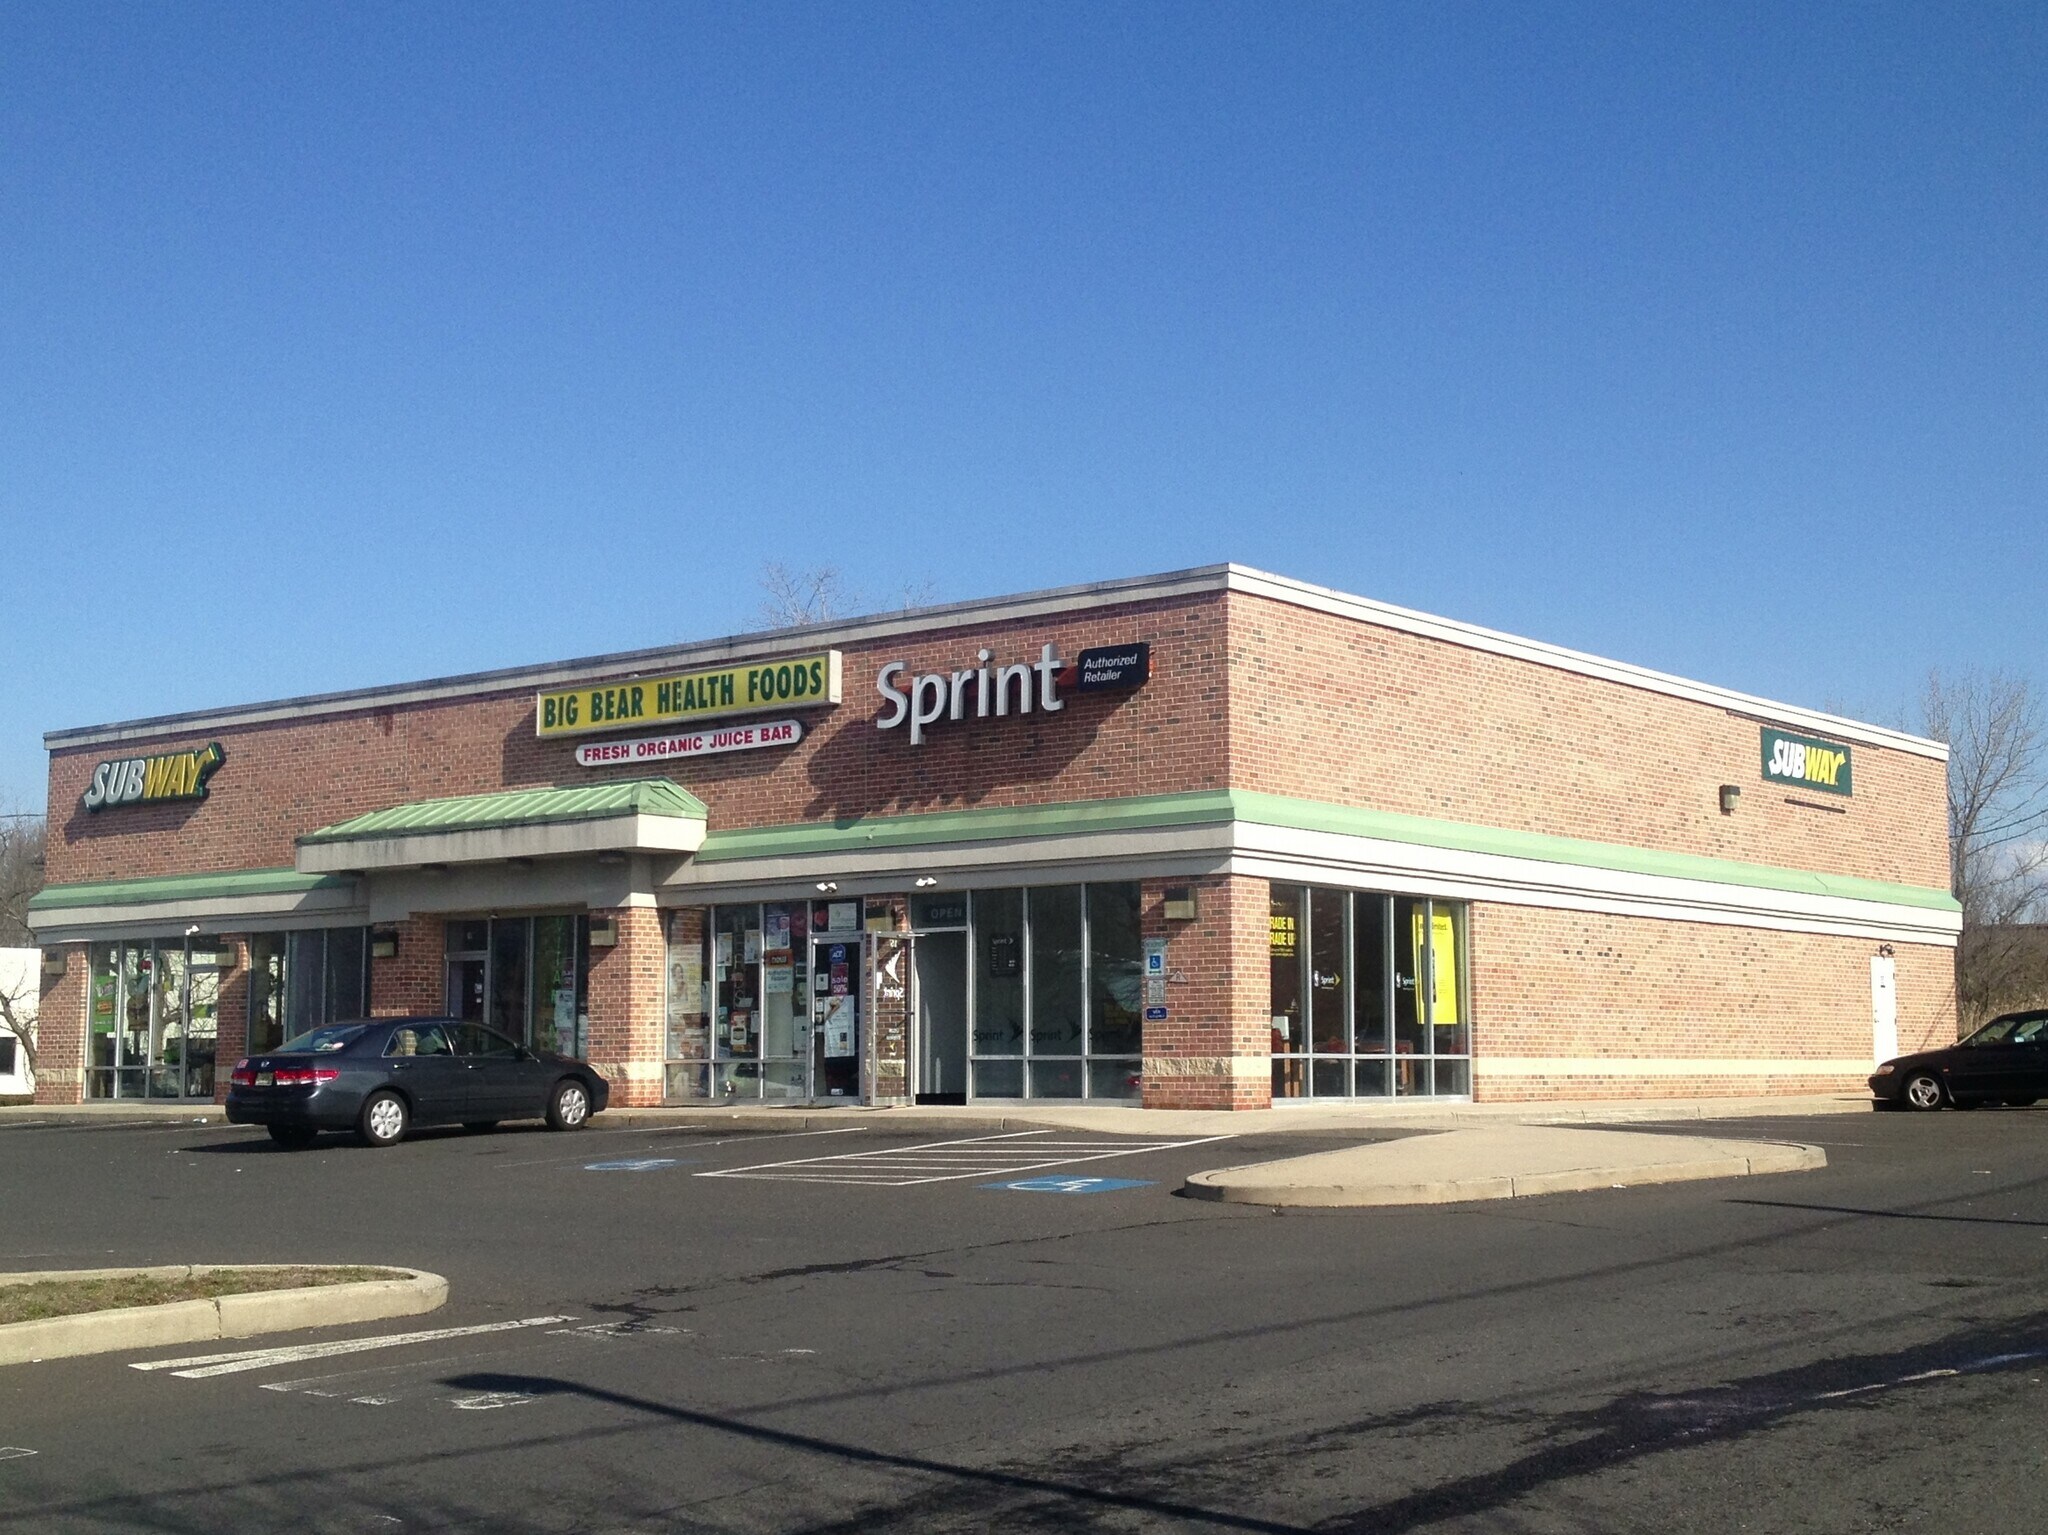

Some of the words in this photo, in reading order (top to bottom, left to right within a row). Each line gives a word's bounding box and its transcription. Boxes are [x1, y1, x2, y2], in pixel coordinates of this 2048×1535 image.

[1083, 653, 1138, 670] Authorized
[1083, 670, 1122, 683] Retailer
[544, 694, 579, 728] BIG
[591, 687, 644, 722] BEAR
[657, 673, 734, 714] HEALTH
[748, 661, 822, 702] FOODS
[876, 642, 1065, 746] Sprint
[583, 745, 630, 762] FRESH
[636, 735, 703, 757] ORGANIC
[709, 730, 753, 749] JUICE
[760, 724, 792, 742] BAR
[1768, 738, 1846, 786] SUBWAY
[83, 747, 215, 806] SUBWAY
[931, 907, 962, 919] OPEN
[974, 1029, 1005, 1043] Sprint
[1031, 1029, 1062, 1043] Sprint
